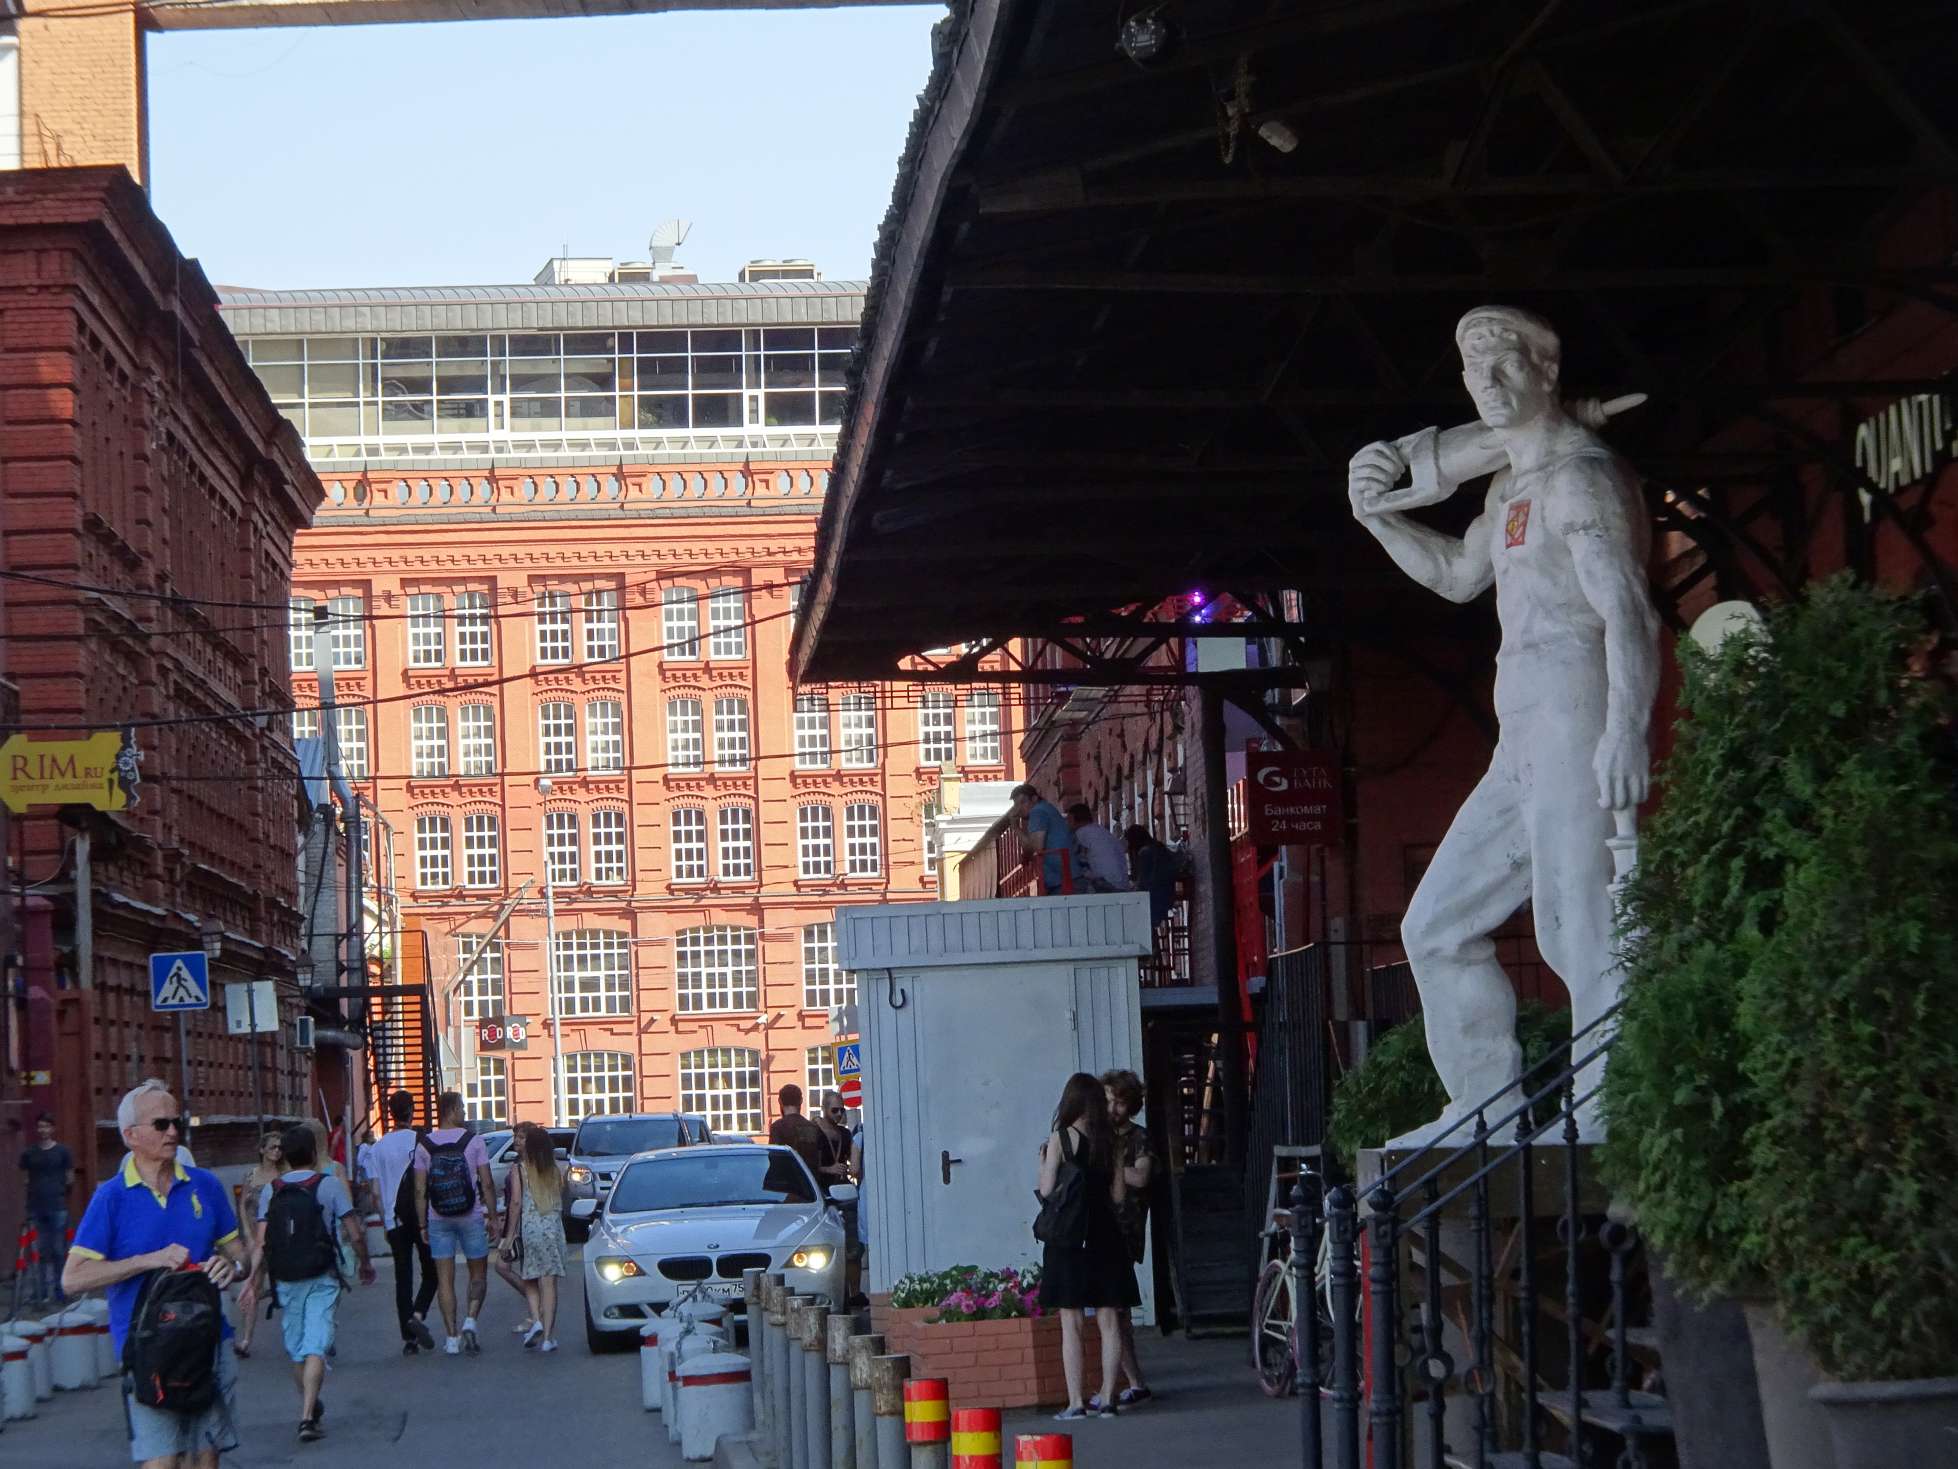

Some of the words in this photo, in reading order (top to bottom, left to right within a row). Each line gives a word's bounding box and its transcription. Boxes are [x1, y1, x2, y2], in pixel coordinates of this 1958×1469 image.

[1293, 778, 1334, 790] БАНК
[1264, 803, 1328, 816] Банкомат
[1271, 820, 1287, 832] 24
[1290, 821, 1322, 832] часа
